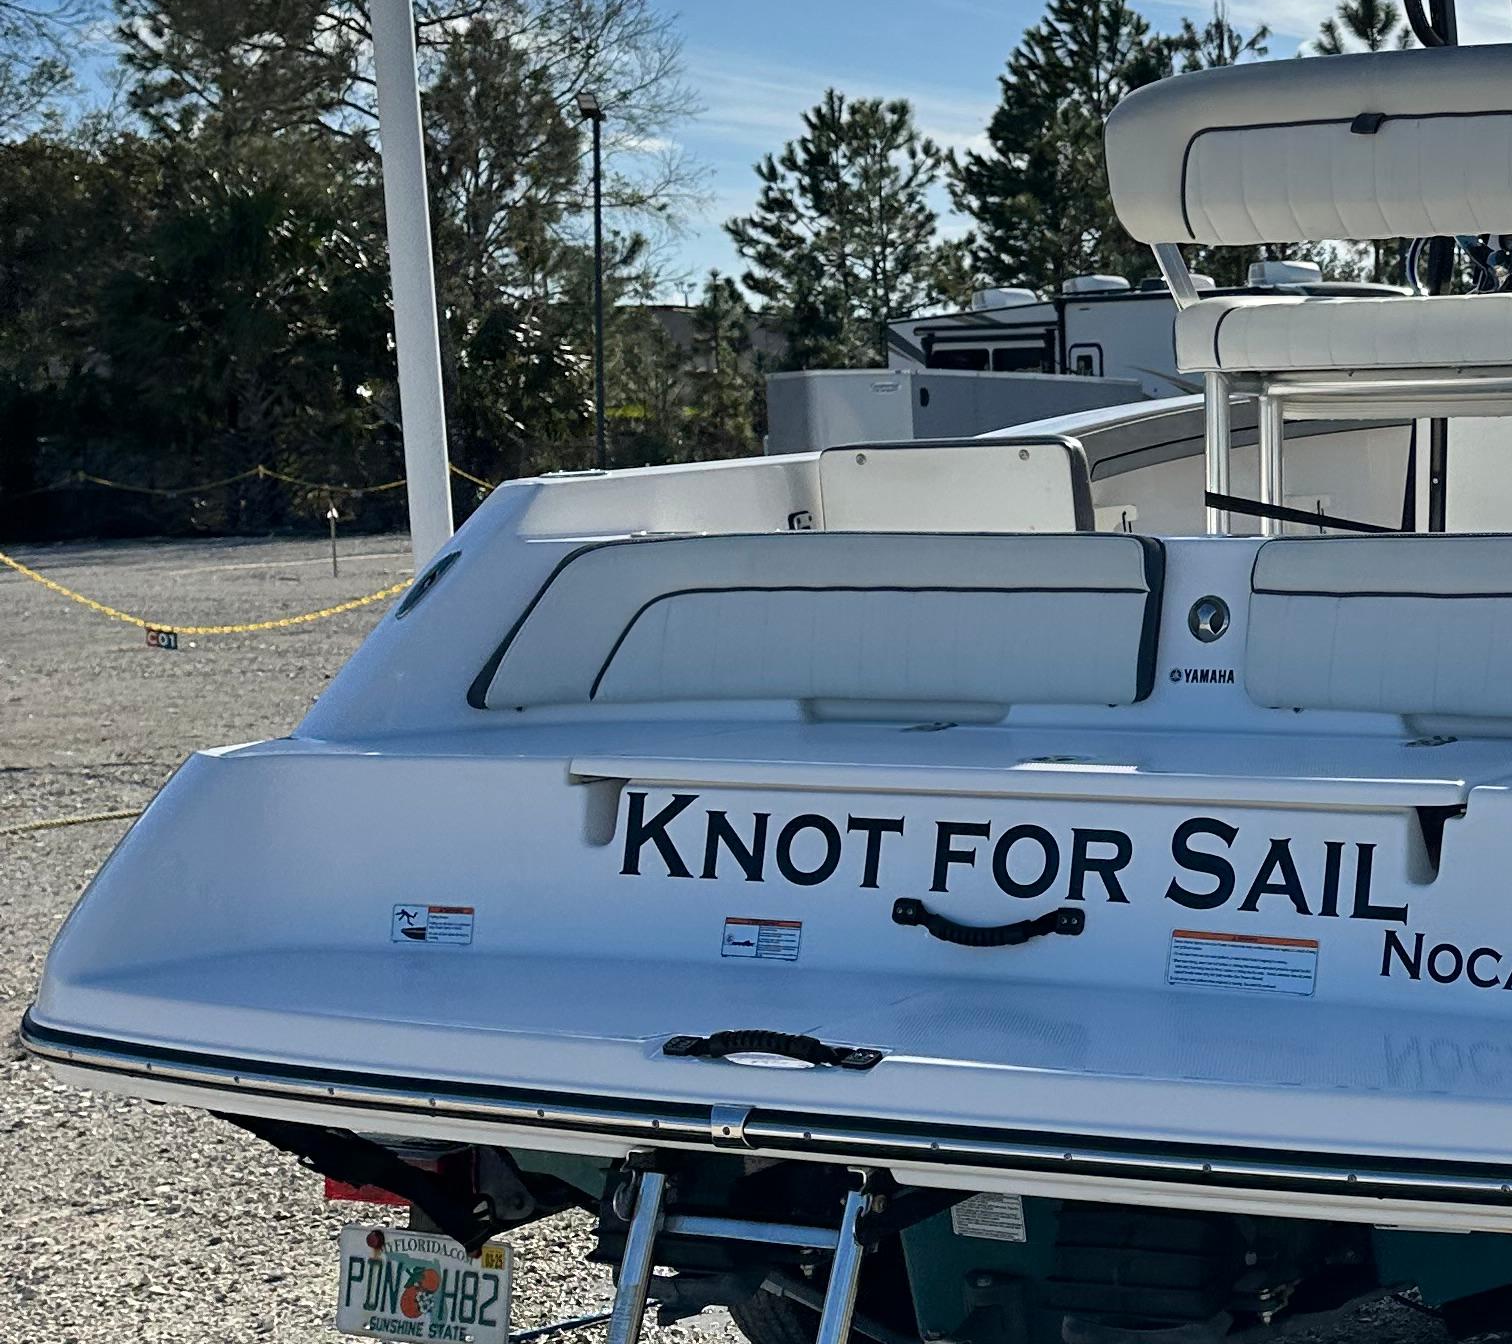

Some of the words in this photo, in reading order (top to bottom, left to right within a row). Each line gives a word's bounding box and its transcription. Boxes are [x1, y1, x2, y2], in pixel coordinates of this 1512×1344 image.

[1184, 668, 1235, 684] YAMAHA
[618, 791, 905, 889] KNOT
[928, 820, 1134, 904] FOR
[1164, 816, 1409, 926] SAIL
[381, 1236, 475, 1267] YFLORIDA.COM
[438, 1268, 500, 1327] H82
[369, 1316, 425, 1338] SUNSHINE
[428, 1323, 468, 1342] STATE
